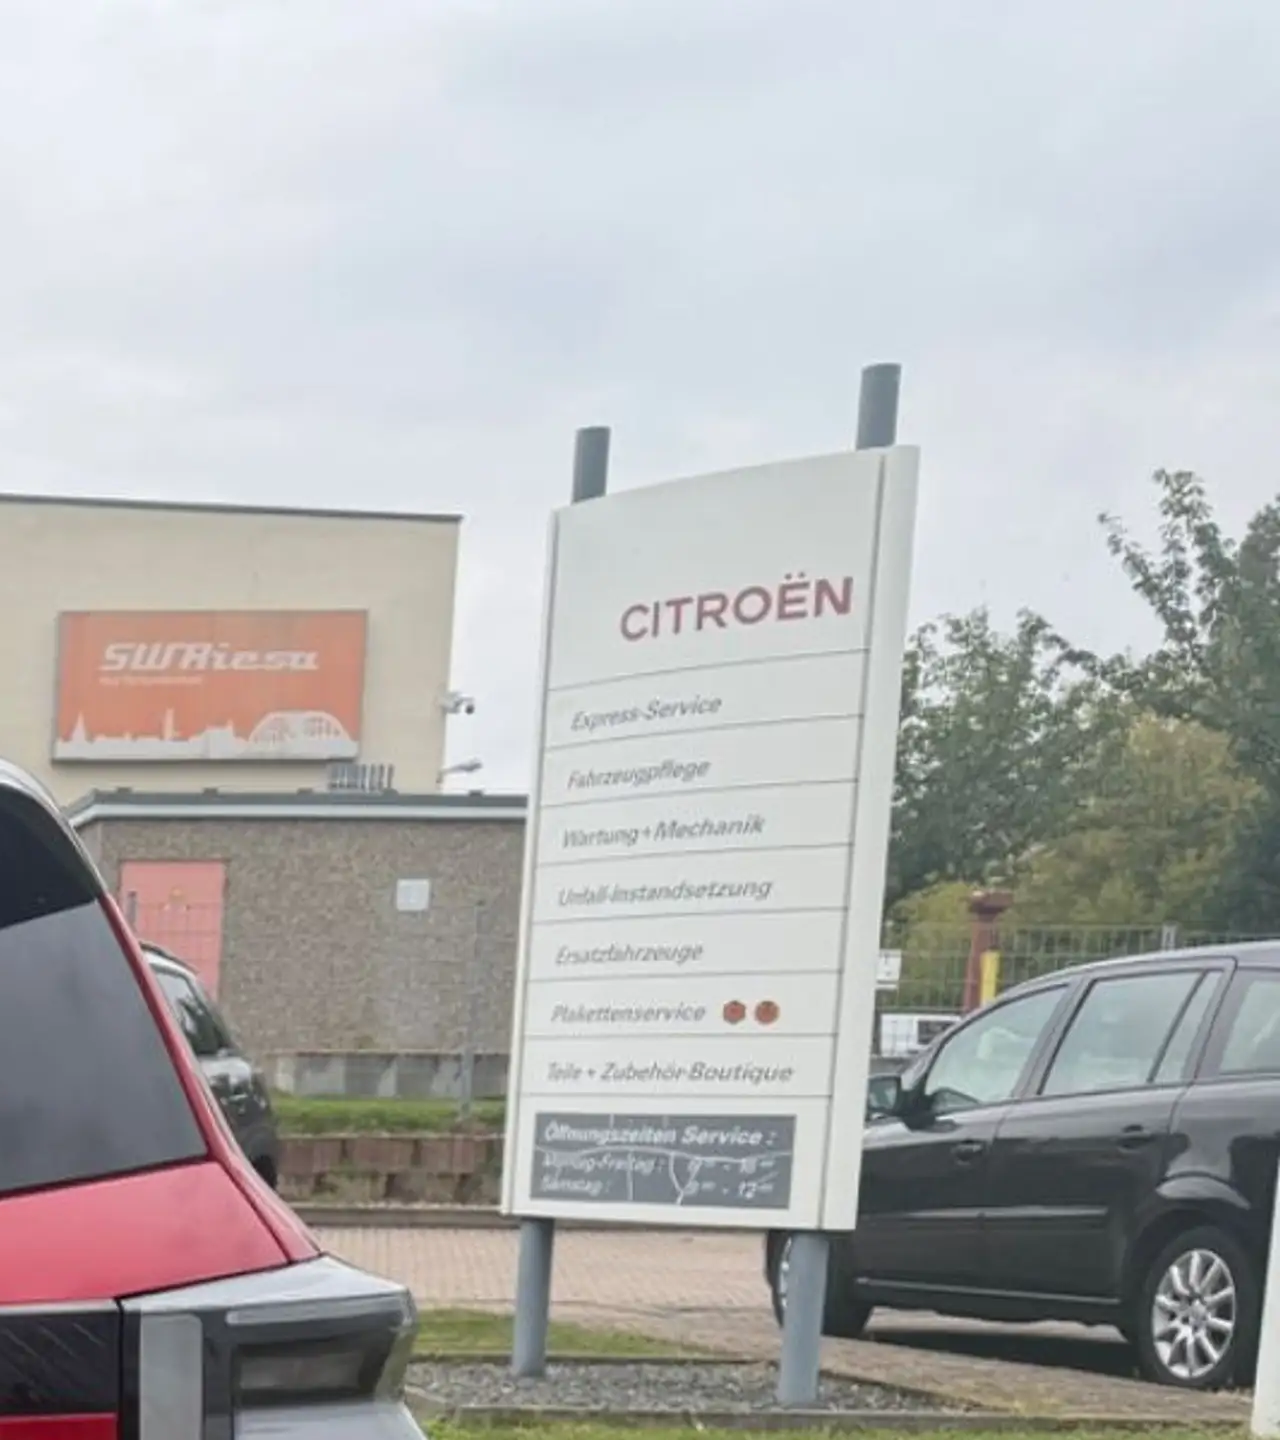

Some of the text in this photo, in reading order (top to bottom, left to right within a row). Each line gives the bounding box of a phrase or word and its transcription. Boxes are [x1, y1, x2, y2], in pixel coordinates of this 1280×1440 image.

[620, 571, 854, 641] CITROËN
[567, 760, 711, 790] Fahrzeugpflege
[555, 943, 704, 966] Ersatzfahrzeuge
[550, 1002, 706, 1023] Plakettenservice
